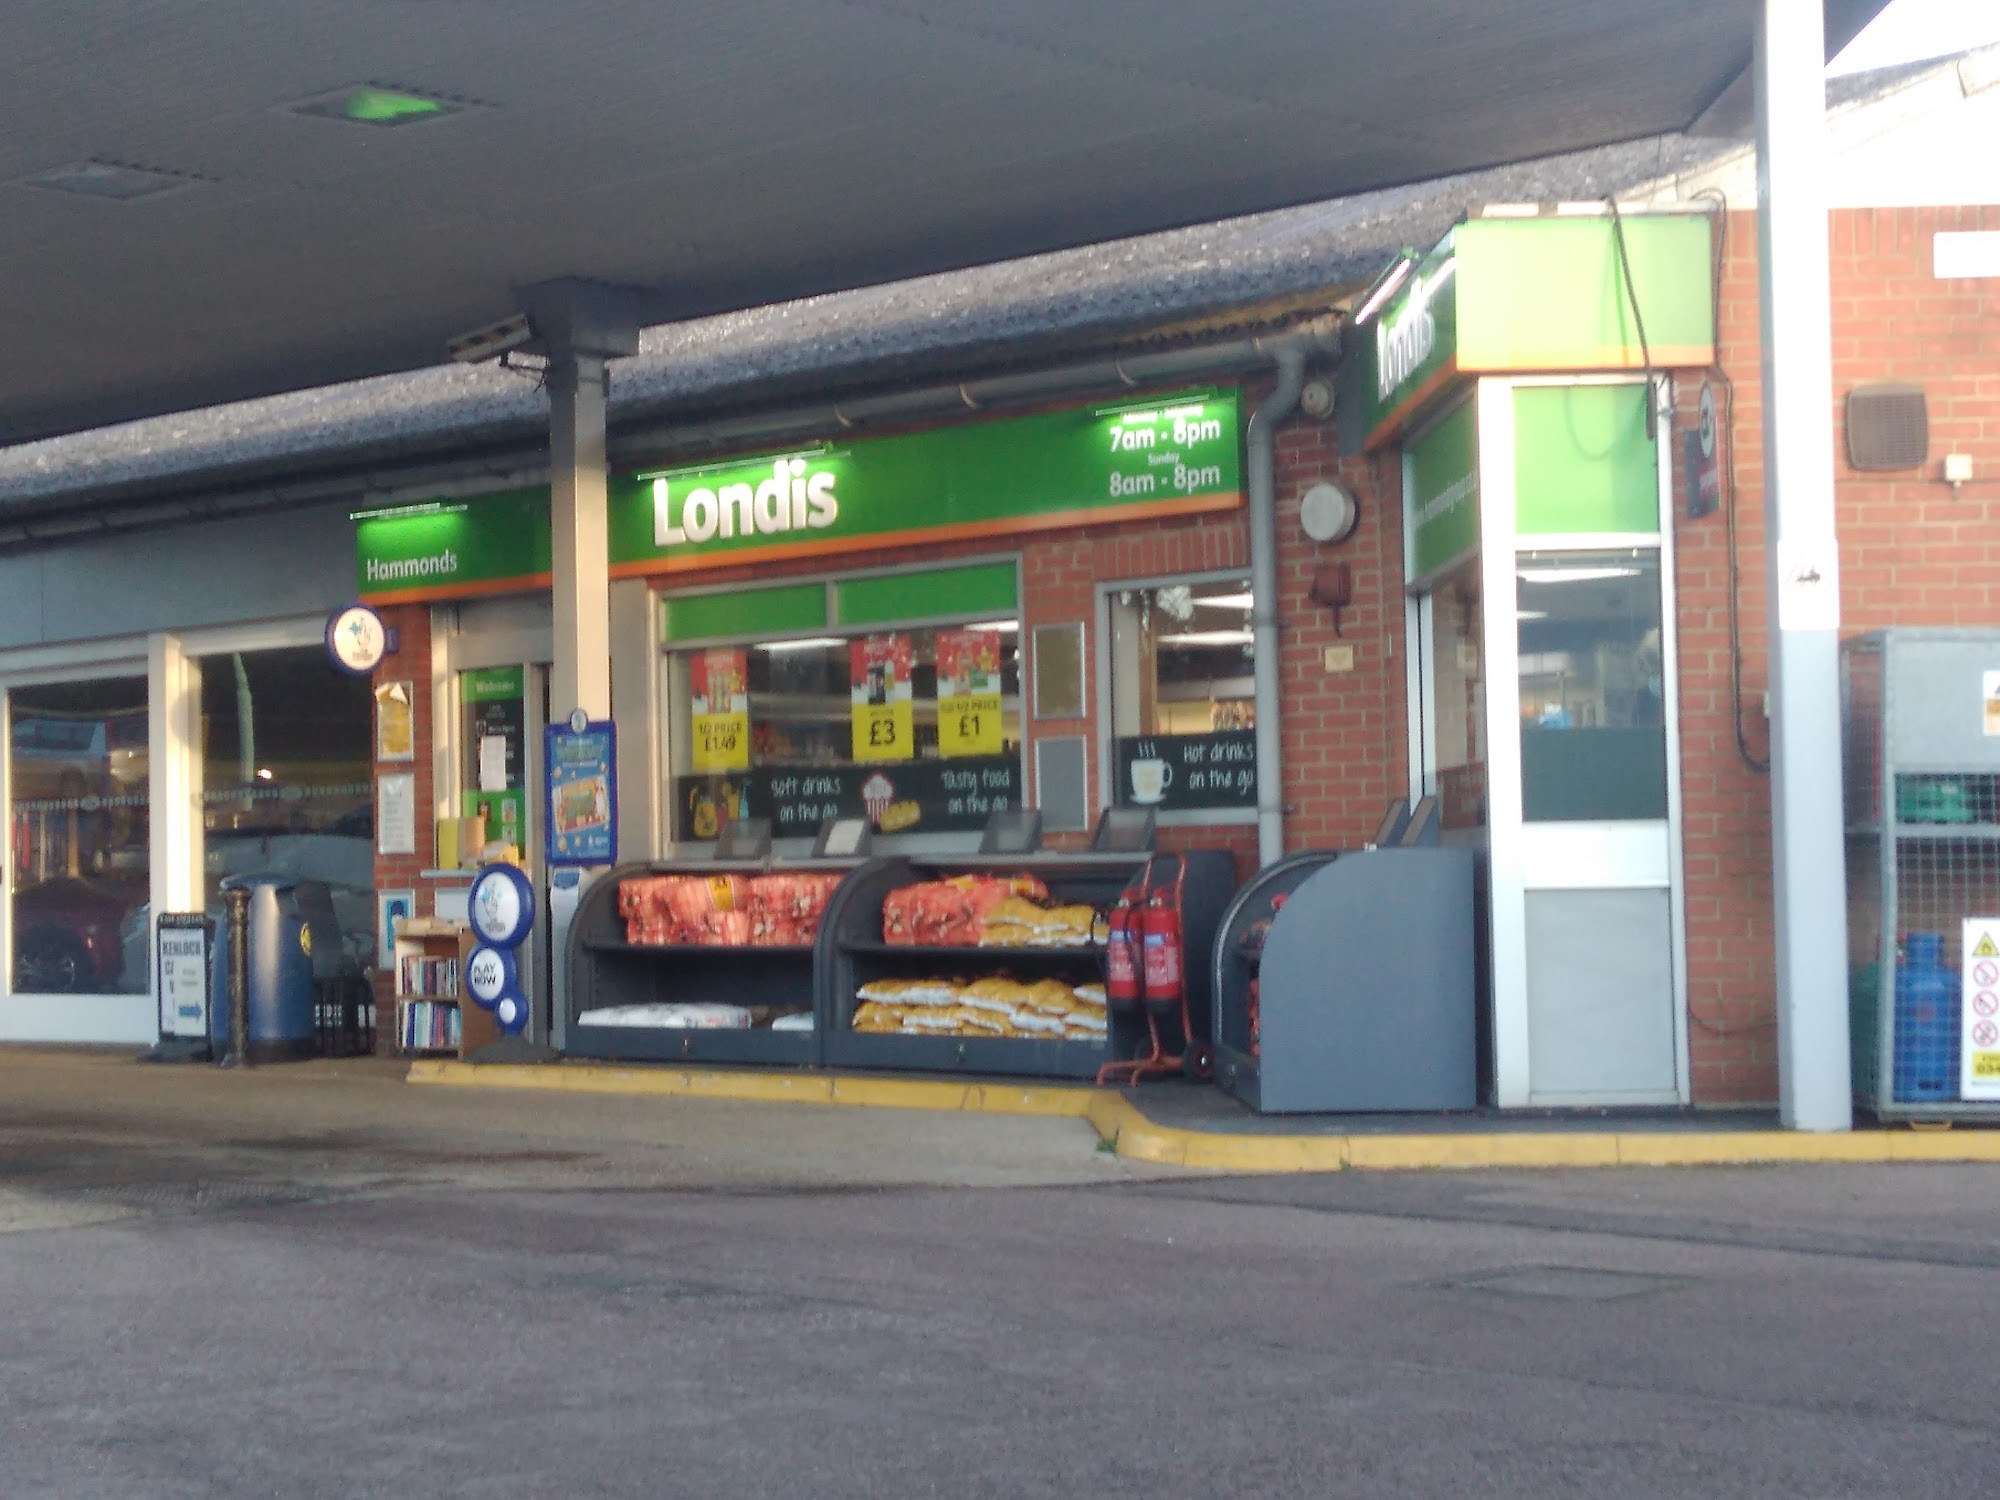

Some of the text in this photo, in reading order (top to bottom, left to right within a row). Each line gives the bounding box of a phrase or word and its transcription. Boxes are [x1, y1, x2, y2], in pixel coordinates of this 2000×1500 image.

[1109, 426, 1156, 453] 7am
[1172, 416, 1221, 449] 8pm
[1147, 452, 1180, 467] Sunday
[1109, 471, 1155, 498] 8am
[1173, 463, 1221, 495] 8pm
[653, 458, 839, 547] Londis
[366, 548, 458, 582] Hammonds
[869, 720, 896, 745] £3
[958, 713, 980, 737] £1
[1183, 740, 1254, 763] Hot drinks
[802, 775, 841, 797] drinks
[943, 767, 1010, 798] Tasty food
[1189, 768, 1254, 797] on the go
[780, 805, 794, 822] on
[797, 801, 818, 822] the
[948, 798, 962, 815] on
[965, 795, 988, 814] the
[473, 962, 496, 975] PLAY
[474, 976, 496, 986] NOW
